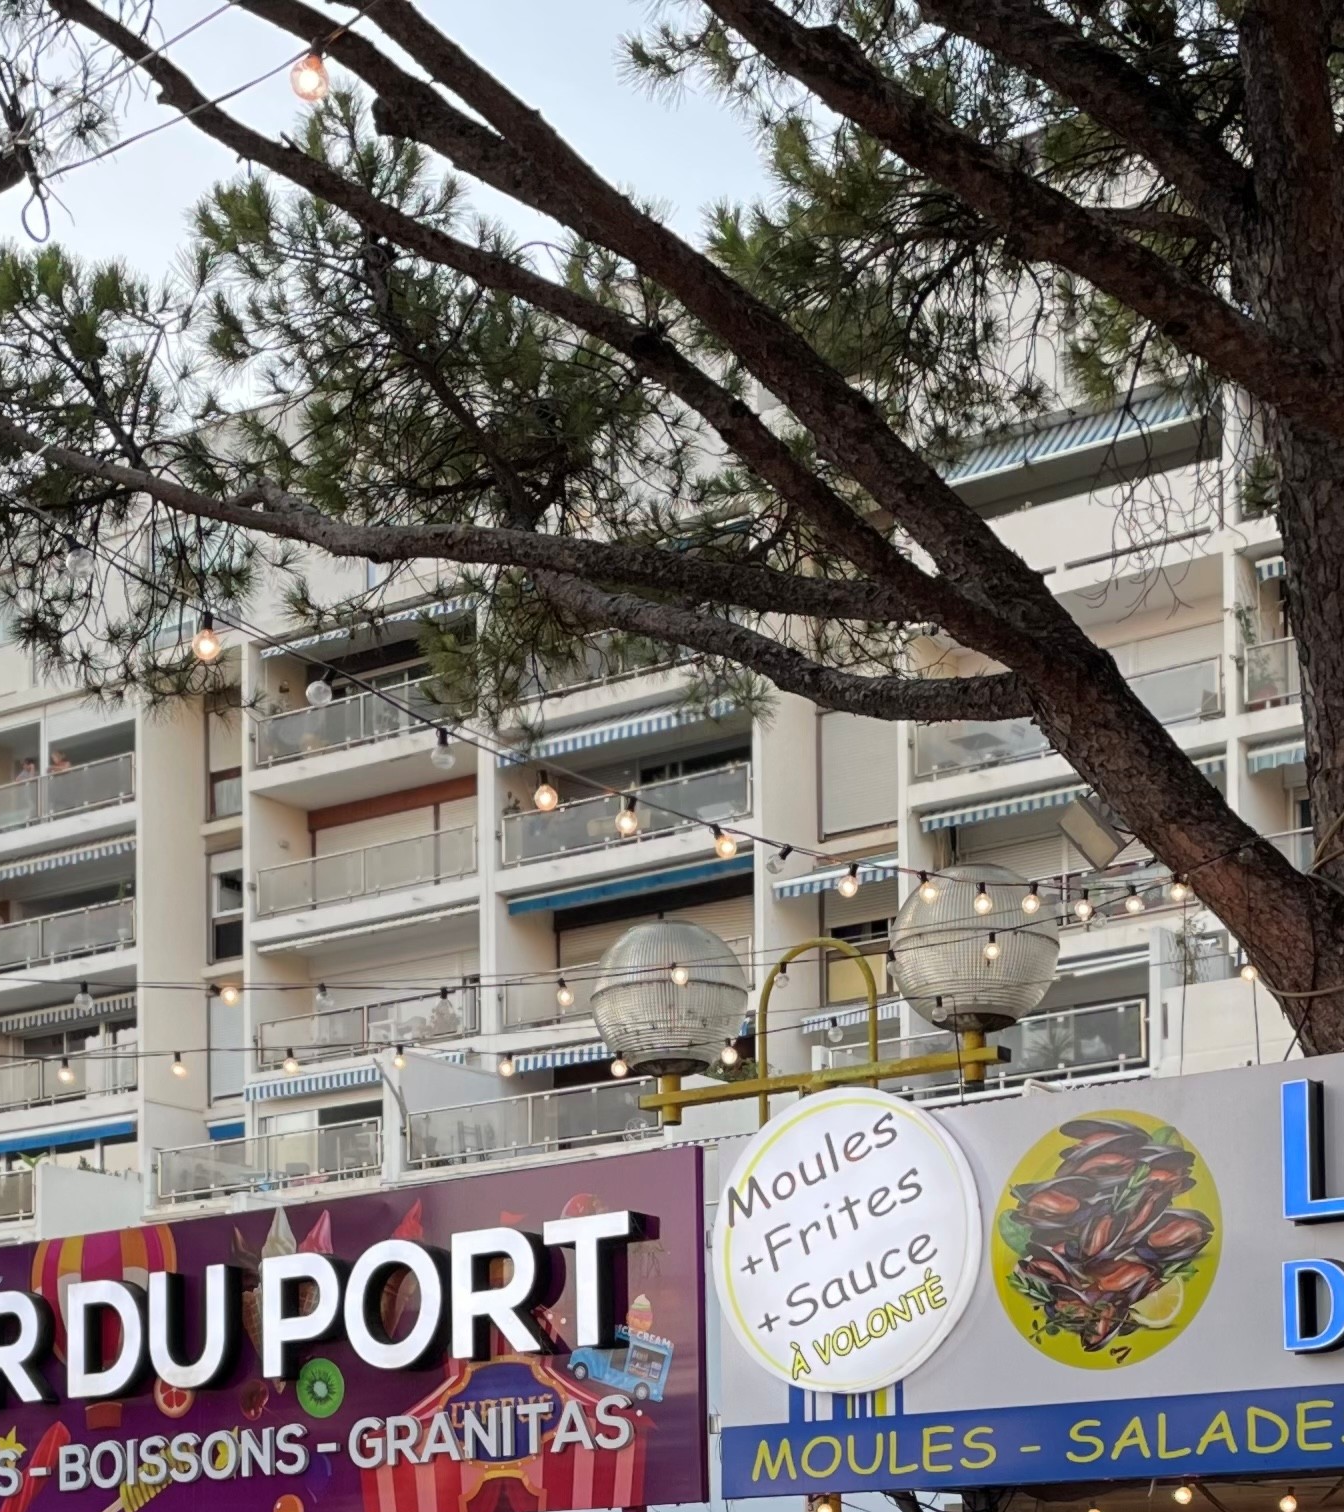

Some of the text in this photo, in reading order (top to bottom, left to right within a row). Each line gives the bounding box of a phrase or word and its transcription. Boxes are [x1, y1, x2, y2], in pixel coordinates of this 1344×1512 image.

[724, 1112, 899, 1229] Moules
[67, 1263, 228, 1398] DU
[261, 1210, 631, 1379] PORT
[790, 1268, 948, 1380] À VOLONTÉ
[58, 1423, 311, 1494] BOISSONS
[348, 1394, 635, 1470] GRANITAS
[751, 1425, 998, 1482] MOULES
